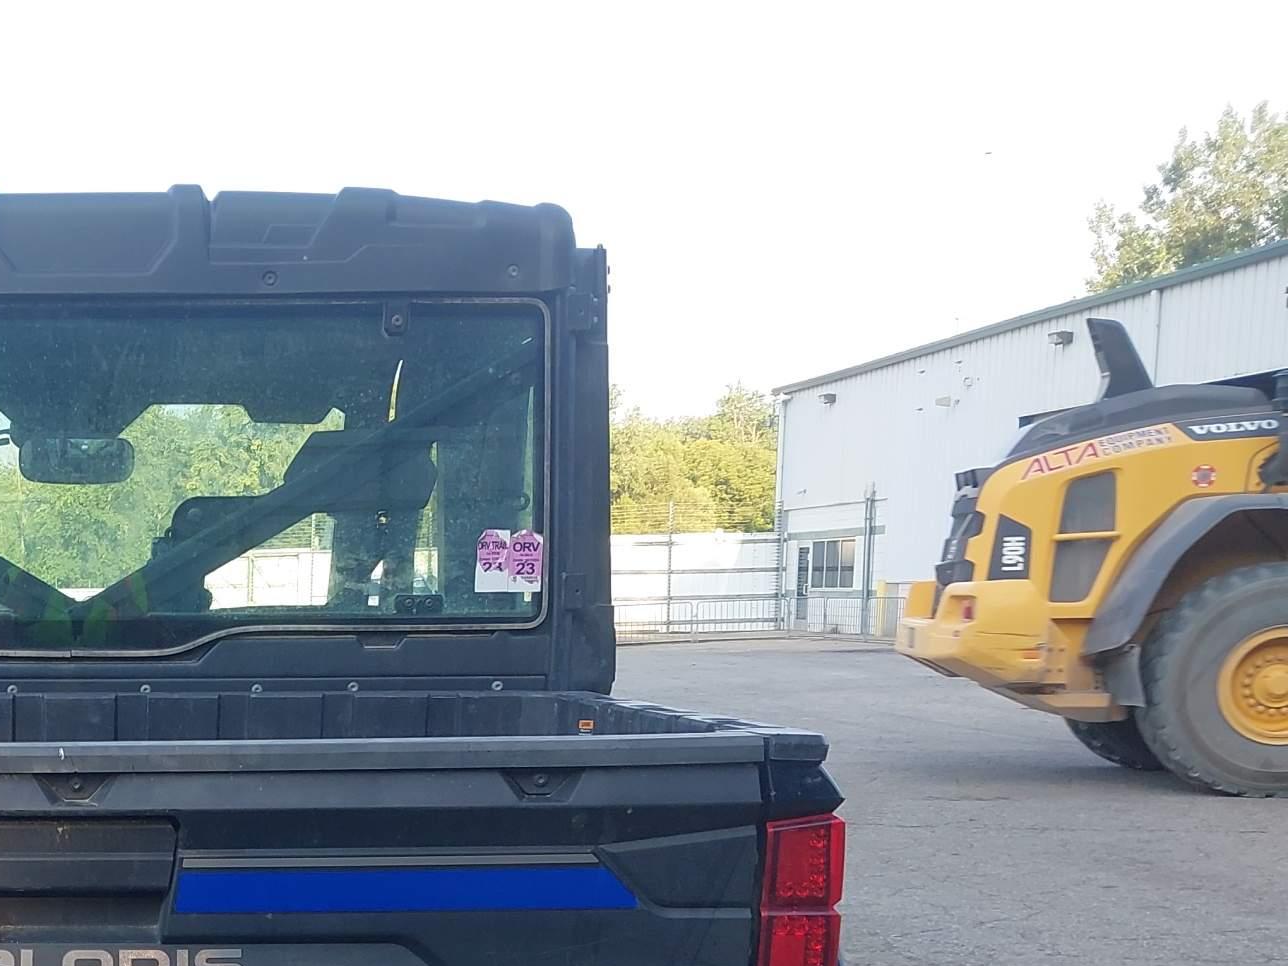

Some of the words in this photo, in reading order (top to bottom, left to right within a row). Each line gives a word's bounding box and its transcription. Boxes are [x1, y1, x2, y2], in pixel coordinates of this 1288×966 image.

[1099, 426, 1170, 447] EQUIPMENT
[1188, 419, 1279, 435] VOLVO
[1102, 436, 1173, 457] COMPANY
[1021, 442, 1099, 480] ALTA
[512, 541, 541, 553] ORV
[1001, 536, 1026, 571] L90H
[515, 562, 536, 575] 23
